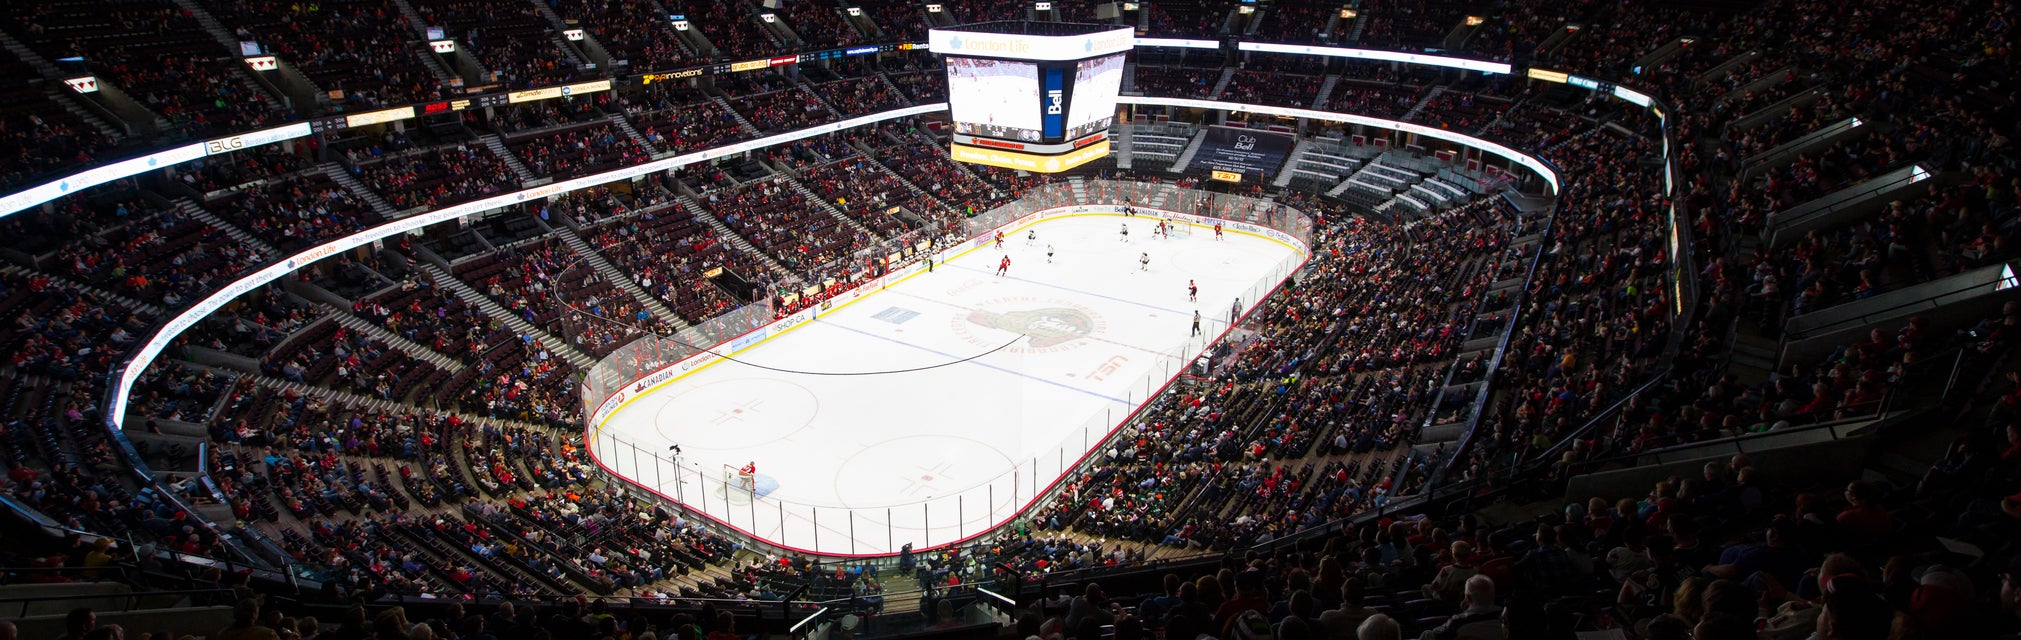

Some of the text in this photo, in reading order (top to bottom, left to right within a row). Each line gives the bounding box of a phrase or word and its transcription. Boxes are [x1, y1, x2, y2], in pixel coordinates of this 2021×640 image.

[965, 38, 1031, 53] London Life
[425, 102, 448, 114] ROSS
[1048, 90, 1062, 114] Bell
[209, 137, 242, 153] BLG
[1234, 142, 1254, 151] Bell
[1238, 135, 1256, 144] Club
[526, 189, 551, 198] London
[551, 185, 563, 193] Life
[587, 175, 610, 185] freedom
[648, 164, 664, 172] power
[1137, 208, 1158, 216] CANADIAN
[1204, 218, 1226, 226] POPEYES
[296, 250, 323, 266] London
[323, 244, 338, 256] Life
[352, 236, 365, 244] The
[365, 227, 393, 241] freedom
[429, 214, 442, 222] The
[443, 208, 463, 220] power
[473, 203, 484, 212] get
[219, 289, 236, 304] power
[235, 285, 244, 293] to
[244, 280, 255, 292] get
[691, 354, 711, 367] London
[643, 369, 673, 389] CANADIAN
[602, 401, 619, 418] AIRLINES
